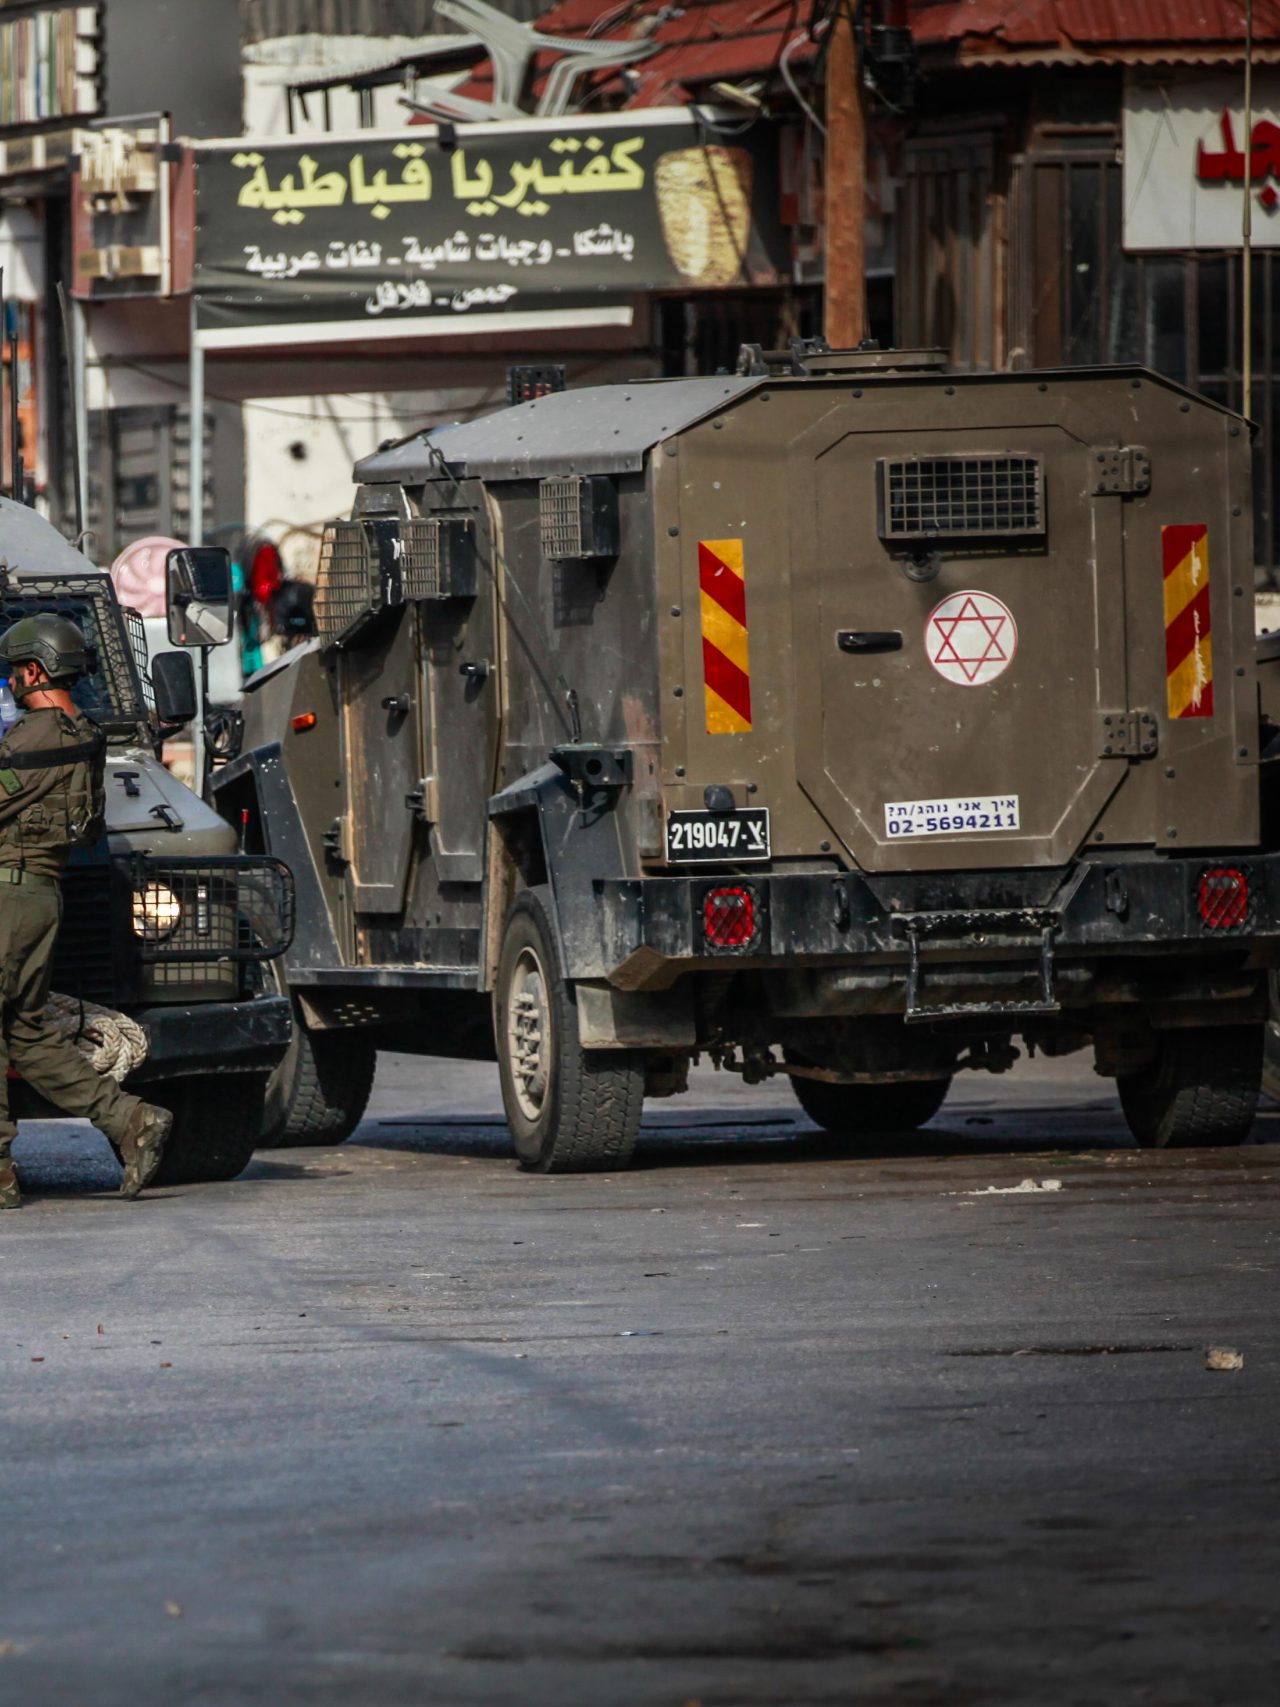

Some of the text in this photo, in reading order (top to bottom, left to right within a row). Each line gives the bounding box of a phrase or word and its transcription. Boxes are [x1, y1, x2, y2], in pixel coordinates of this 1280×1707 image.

[231, 136, 645, 226] كفتيريا قباطية
[243, 245, 321, 279] عربية
[402, 230, 471, 271] شامية
[475, 232, 553, 266] وجبات
[365, 279, 432, 315] فلافل
[451, 283, 518, 311] حمص
[958, 802, 981, 811] אני
[991, 799, 1016, 812] איך
[888, 813, 1017, 834] 02-5694211
